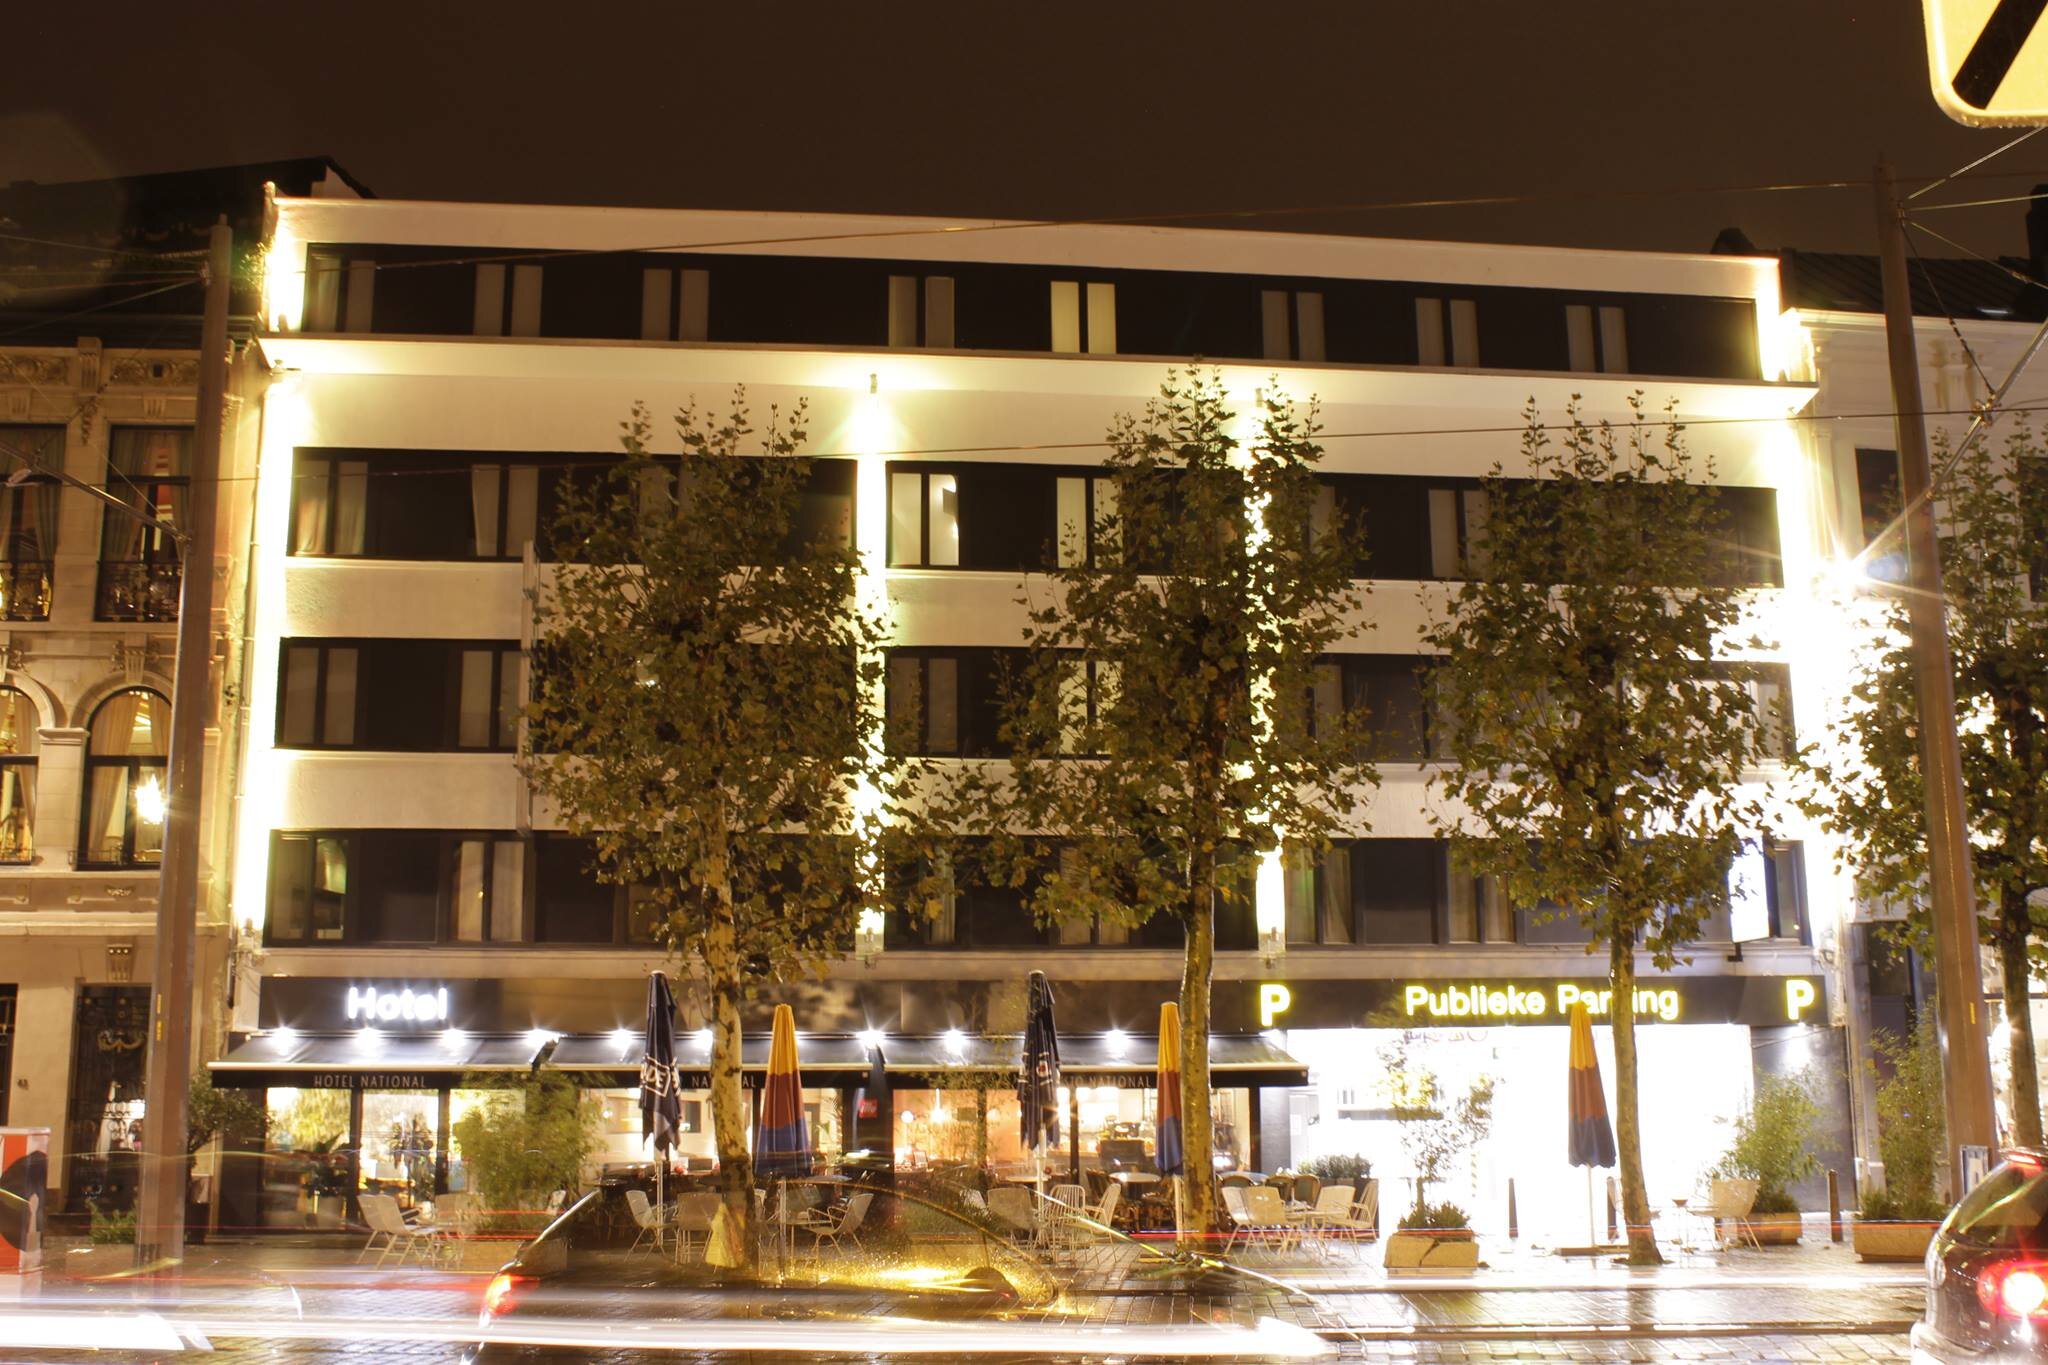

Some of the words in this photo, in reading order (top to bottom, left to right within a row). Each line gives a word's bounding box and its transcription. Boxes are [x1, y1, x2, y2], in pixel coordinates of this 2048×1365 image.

[347, 986, 448, 1021] Hotel
[1260, 984, 1291, 1027] P
[1404, 985, 1546, 1016] Publieke
[1557, 984, 1679, 1021] Paring
[1786, 979, 1815, 1021] P
[314, 1074, 355, 1088] HOTEL
[360, 1074, 427, 1089] NATIONAL
[1088, 1074, 1152, 1089] NATIONAL
